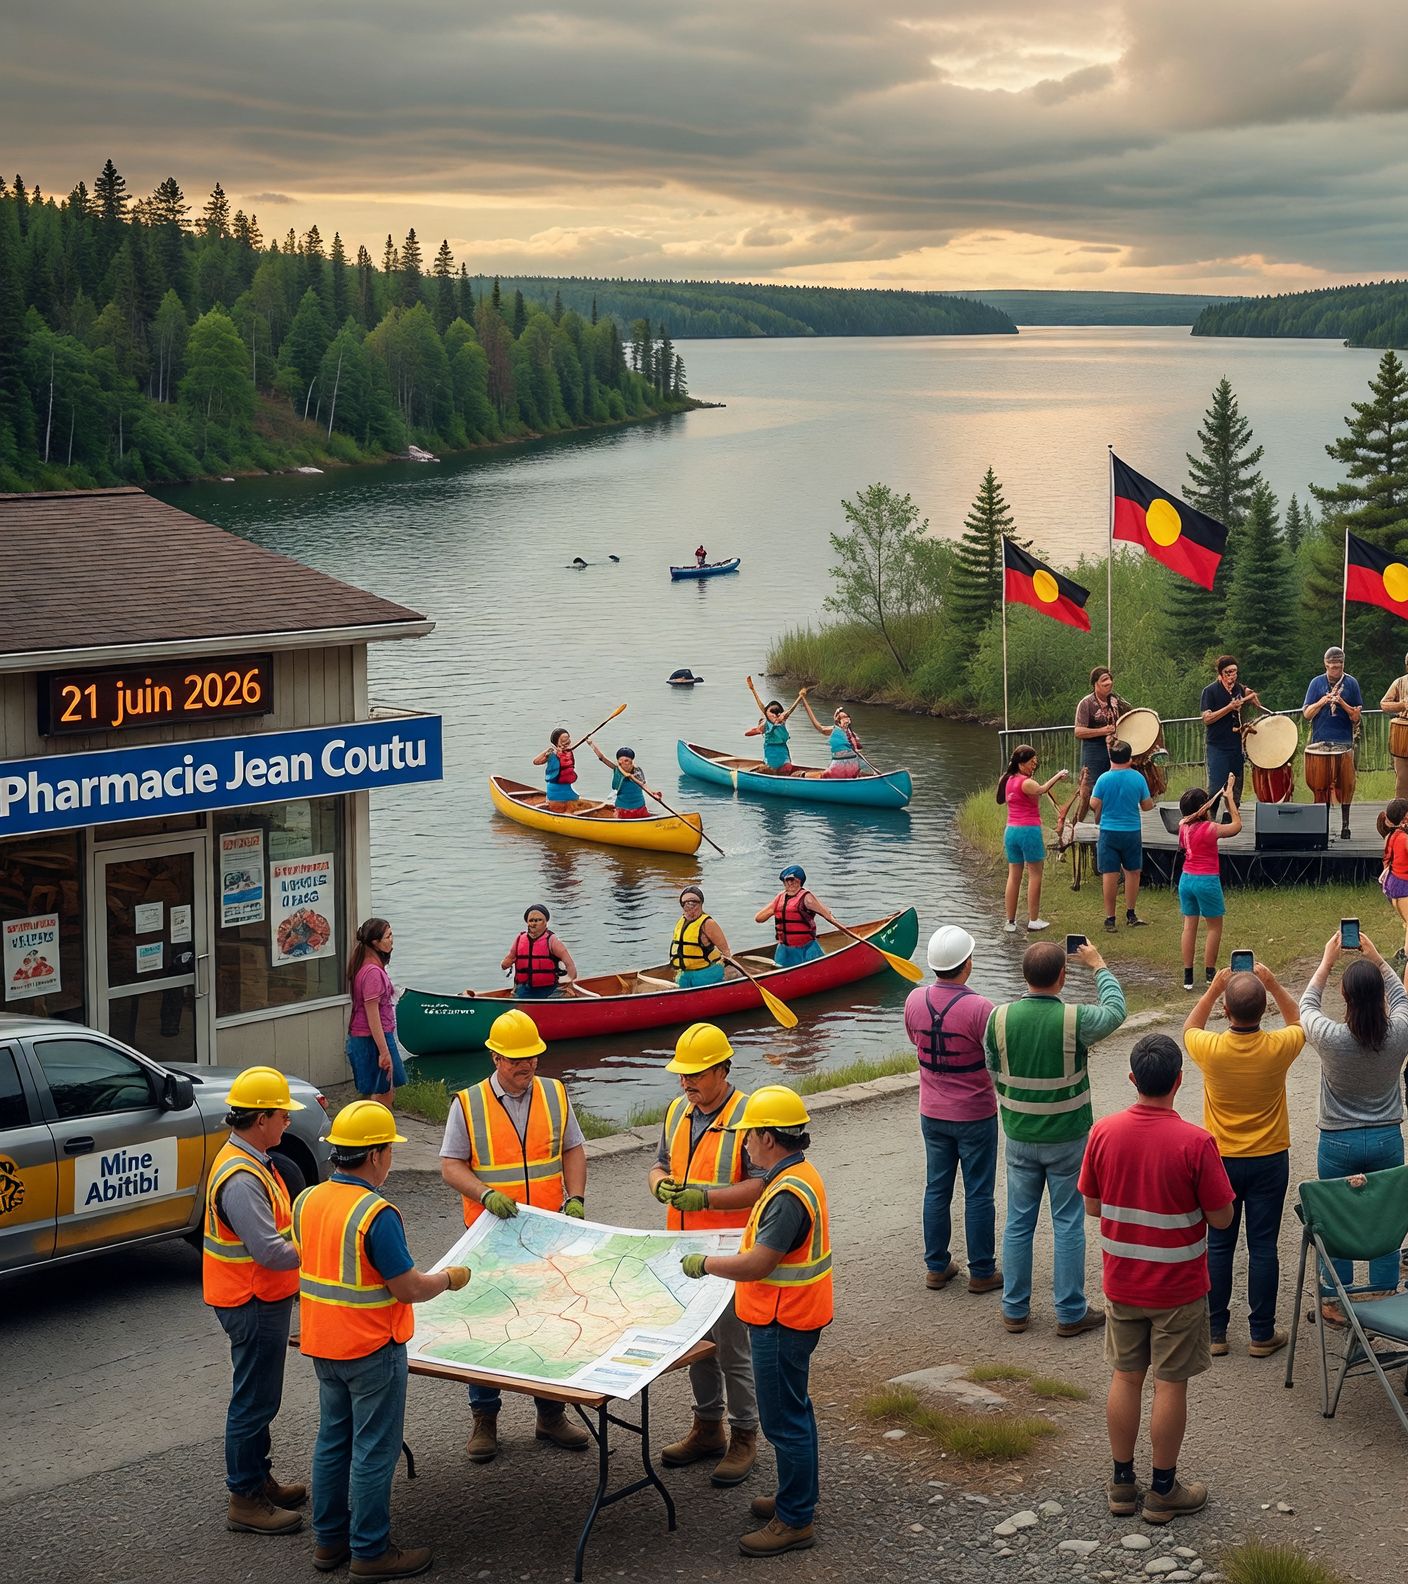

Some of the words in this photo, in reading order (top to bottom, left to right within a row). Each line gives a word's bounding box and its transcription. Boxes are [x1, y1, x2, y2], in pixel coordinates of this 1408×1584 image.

[60, 683, 97, 723] 21
[111, 678, 173, 727] juin
[183, 668, 261, 710] 2026
[0, 755, 218, 817] Pharmacie
[226, 750, 313, 790] Jean
[321, 734, 427, 777] Coutu
[84, 1168, 159, 1206] Abitibi
[100, 1150, 153, 1178] Mine
